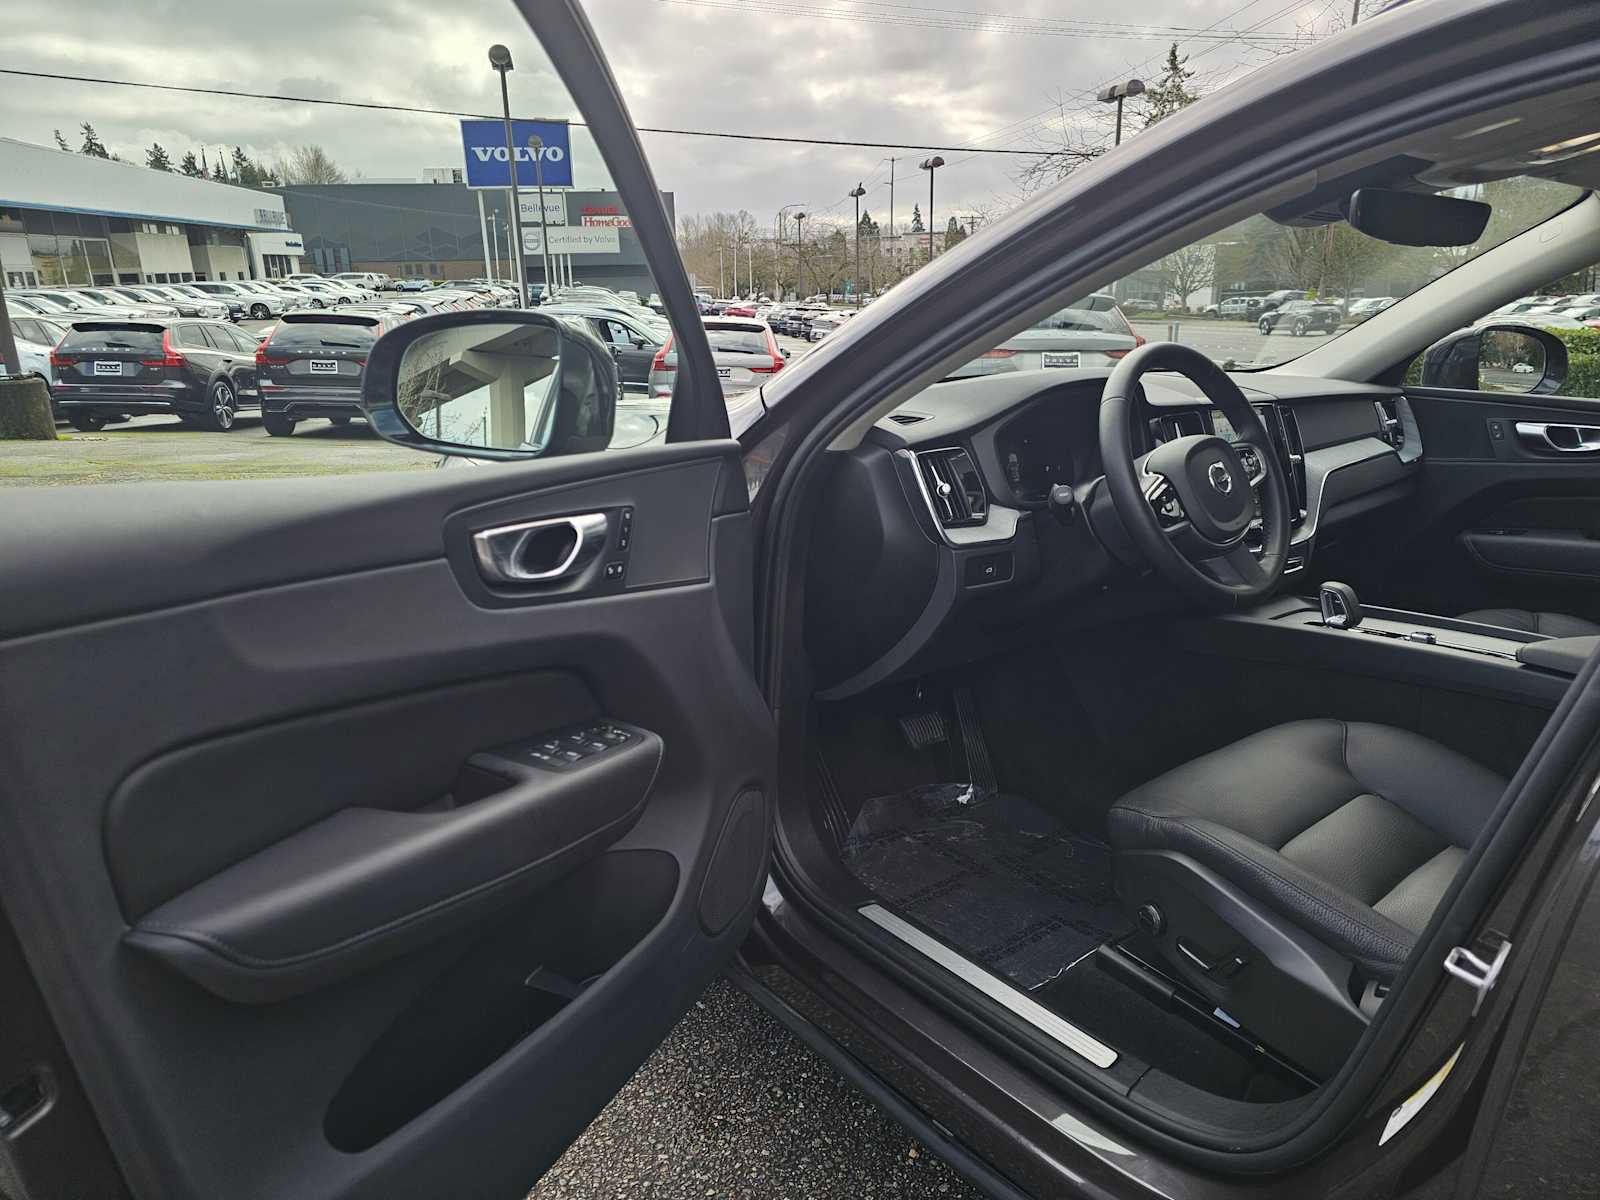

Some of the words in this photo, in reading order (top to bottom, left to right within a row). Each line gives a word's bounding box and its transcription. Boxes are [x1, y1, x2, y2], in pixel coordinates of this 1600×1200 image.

[471, 146, 564, 162] VOLVO
[520, 203, 561, 214] Bellevue
[583, 216, 633, 228] HomeGoo
[583, 235, 593, 246] by
